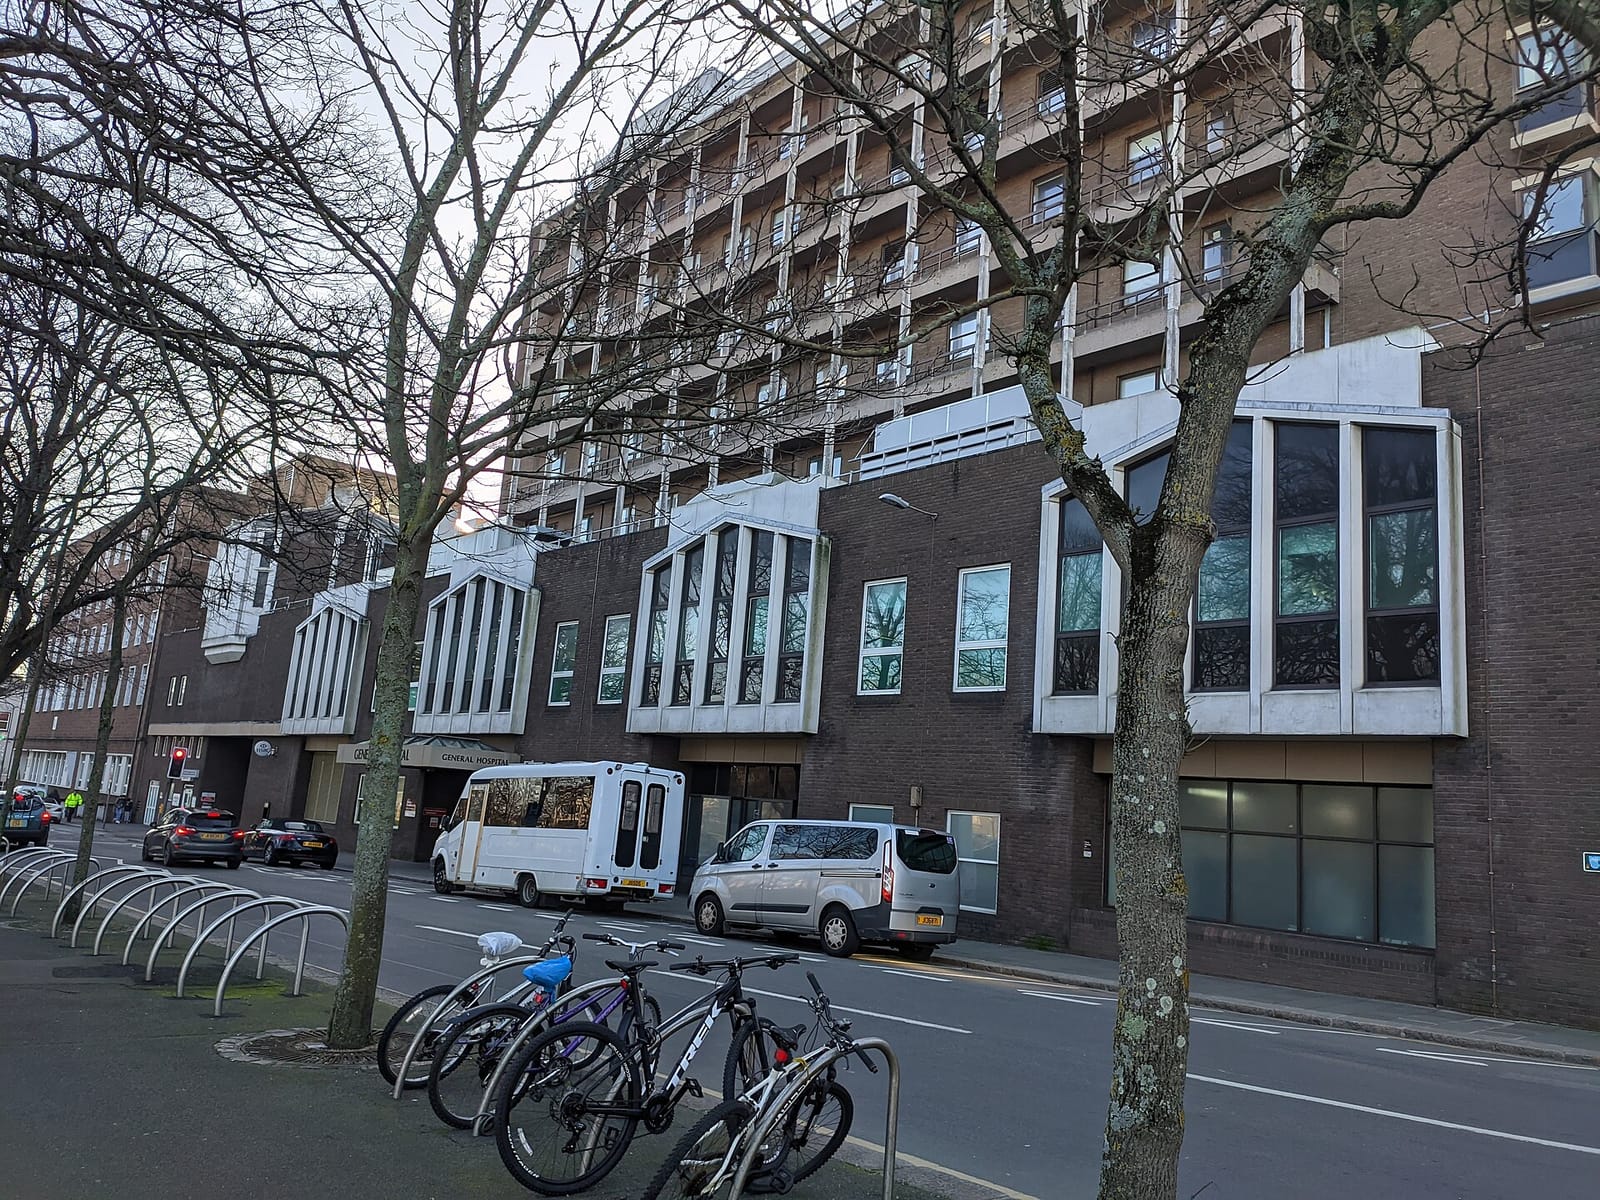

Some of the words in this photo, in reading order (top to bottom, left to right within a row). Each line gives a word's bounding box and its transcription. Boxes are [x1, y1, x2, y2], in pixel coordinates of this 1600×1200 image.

[442, 753, 473, 763] GENERAL
[476, 757, 509, 766] HOSPITAL
[665, 1000, 722, 1090] TREK
